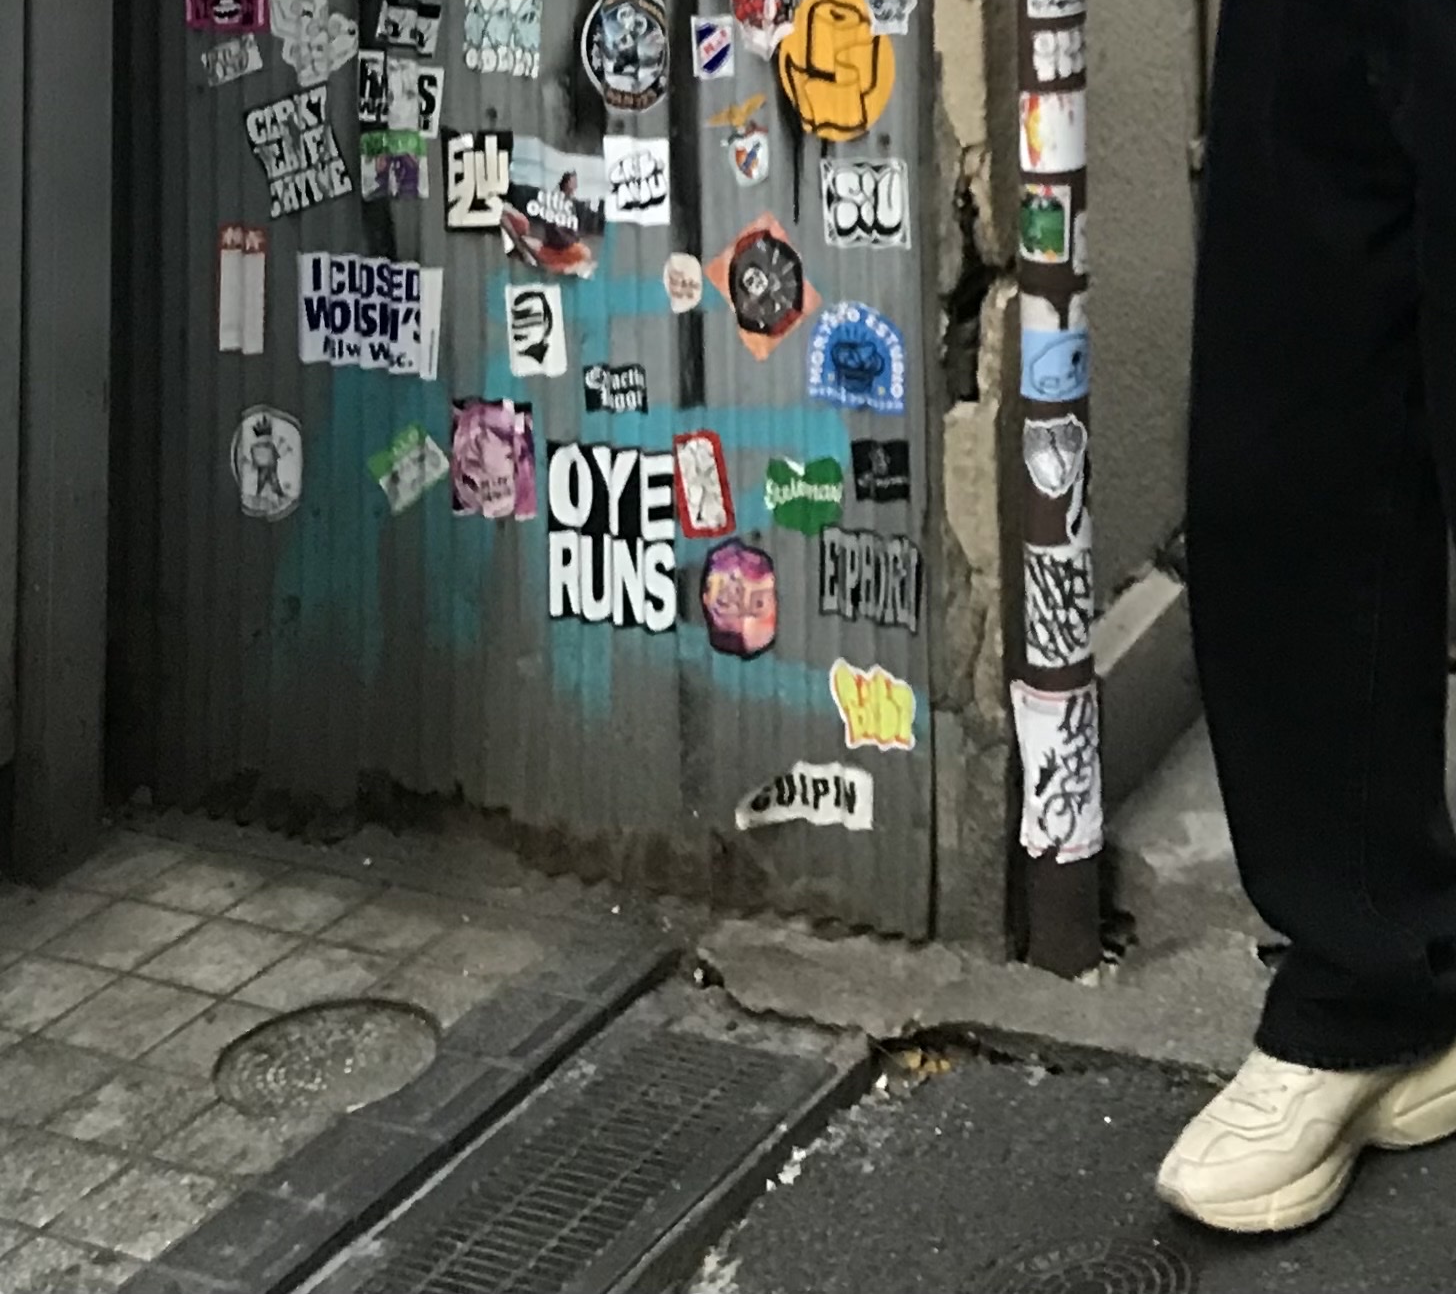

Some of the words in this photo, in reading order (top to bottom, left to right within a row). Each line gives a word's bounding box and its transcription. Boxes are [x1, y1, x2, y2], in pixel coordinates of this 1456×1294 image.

[312, 257, 322, 292] I
[330, 261, 420, 303] CLOSED
[548, 443, 675, 539] OYE
[549, 531, 677, 633] RUNS
